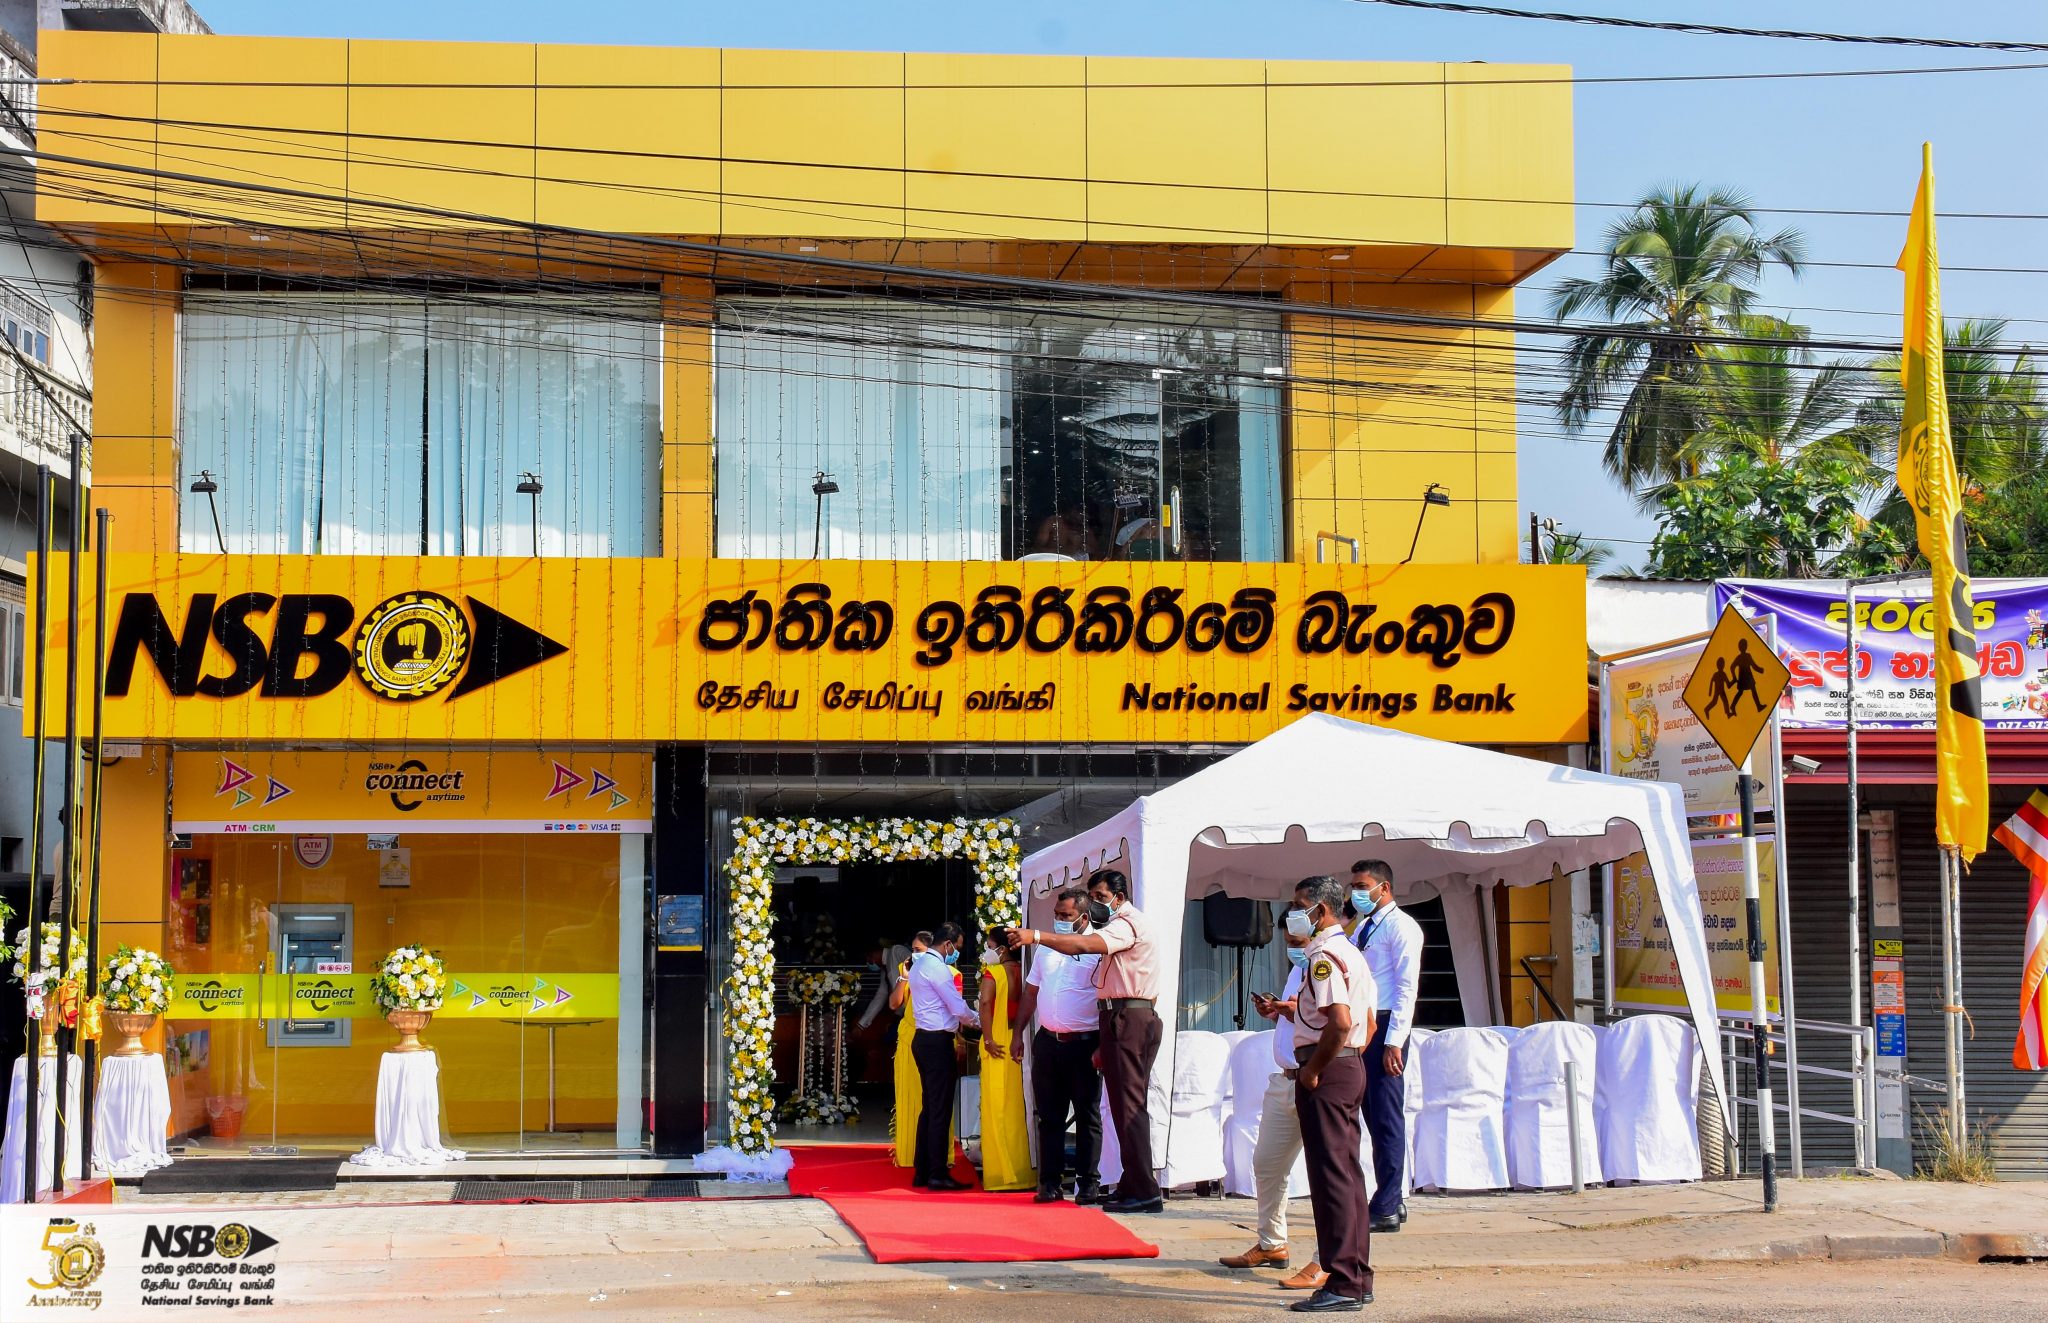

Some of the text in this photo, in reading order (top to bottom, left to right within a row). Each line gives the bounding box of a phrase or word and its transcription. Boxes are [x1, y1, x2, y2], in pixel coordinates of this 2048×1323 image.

[699, 583, 1516, 667] ජාතික ඉතිරිකිරීමේ බැංකුව
[104, 592, 355, 698] NSB
[698, 680, 1056, 717] தேசிய சேமிப்பு வங்கி
[1122, 682, 1516, 718] National Savings Bank
[1909, 688, 1936, 700] විසිතු
[366, 771, 464, 790] connect
[427, 794, 465, 802] anytime
[225, 824, 275, 832] ATM CRM
[184, 986, 243, 999] connect
[296, 986, 355, 998] connect
[489, 990, 530, 998] connect
